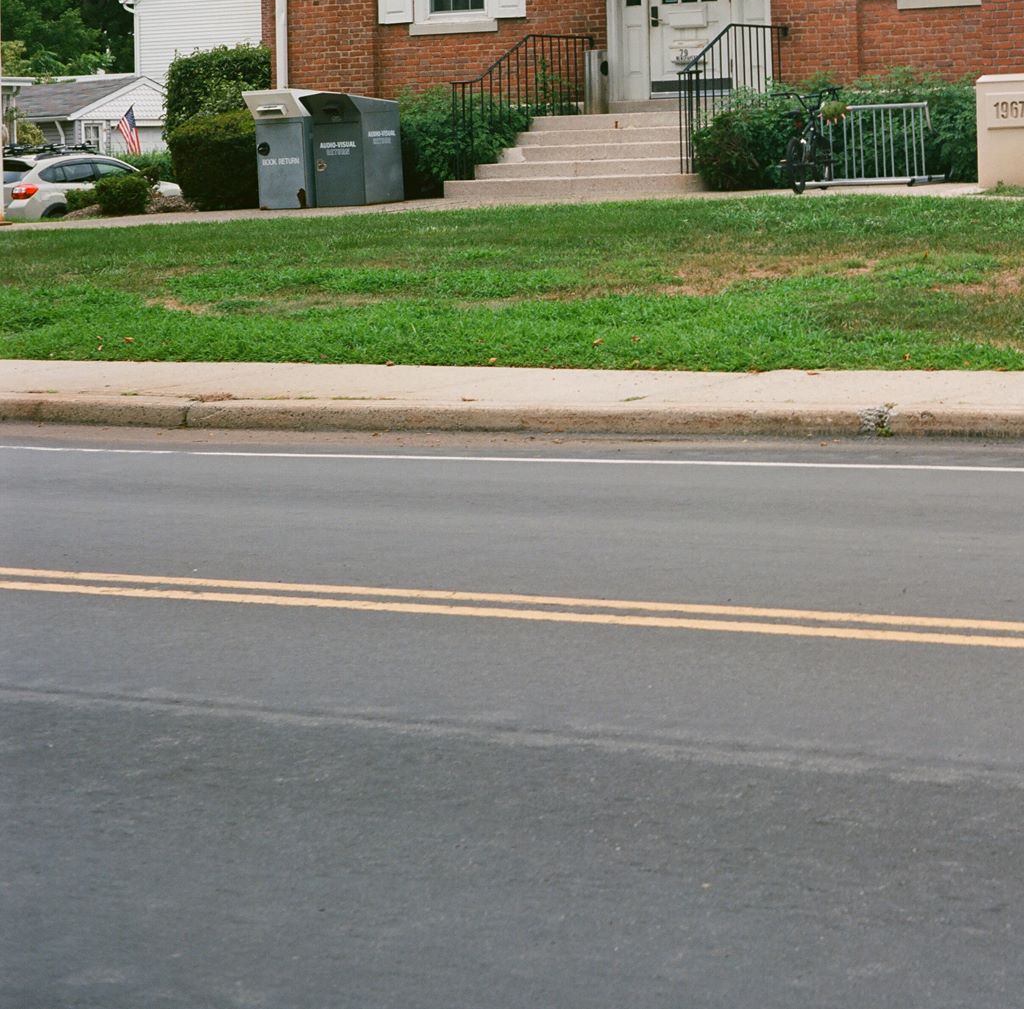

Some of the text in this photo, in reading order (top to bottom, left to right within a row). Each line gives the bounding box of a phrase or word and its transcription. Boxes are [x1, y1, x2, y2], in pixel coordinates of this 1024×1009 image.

[320, 141, 356, 149] AUDIO-VISUAL
[262, 157, 300, 166] BOOK RETURN
